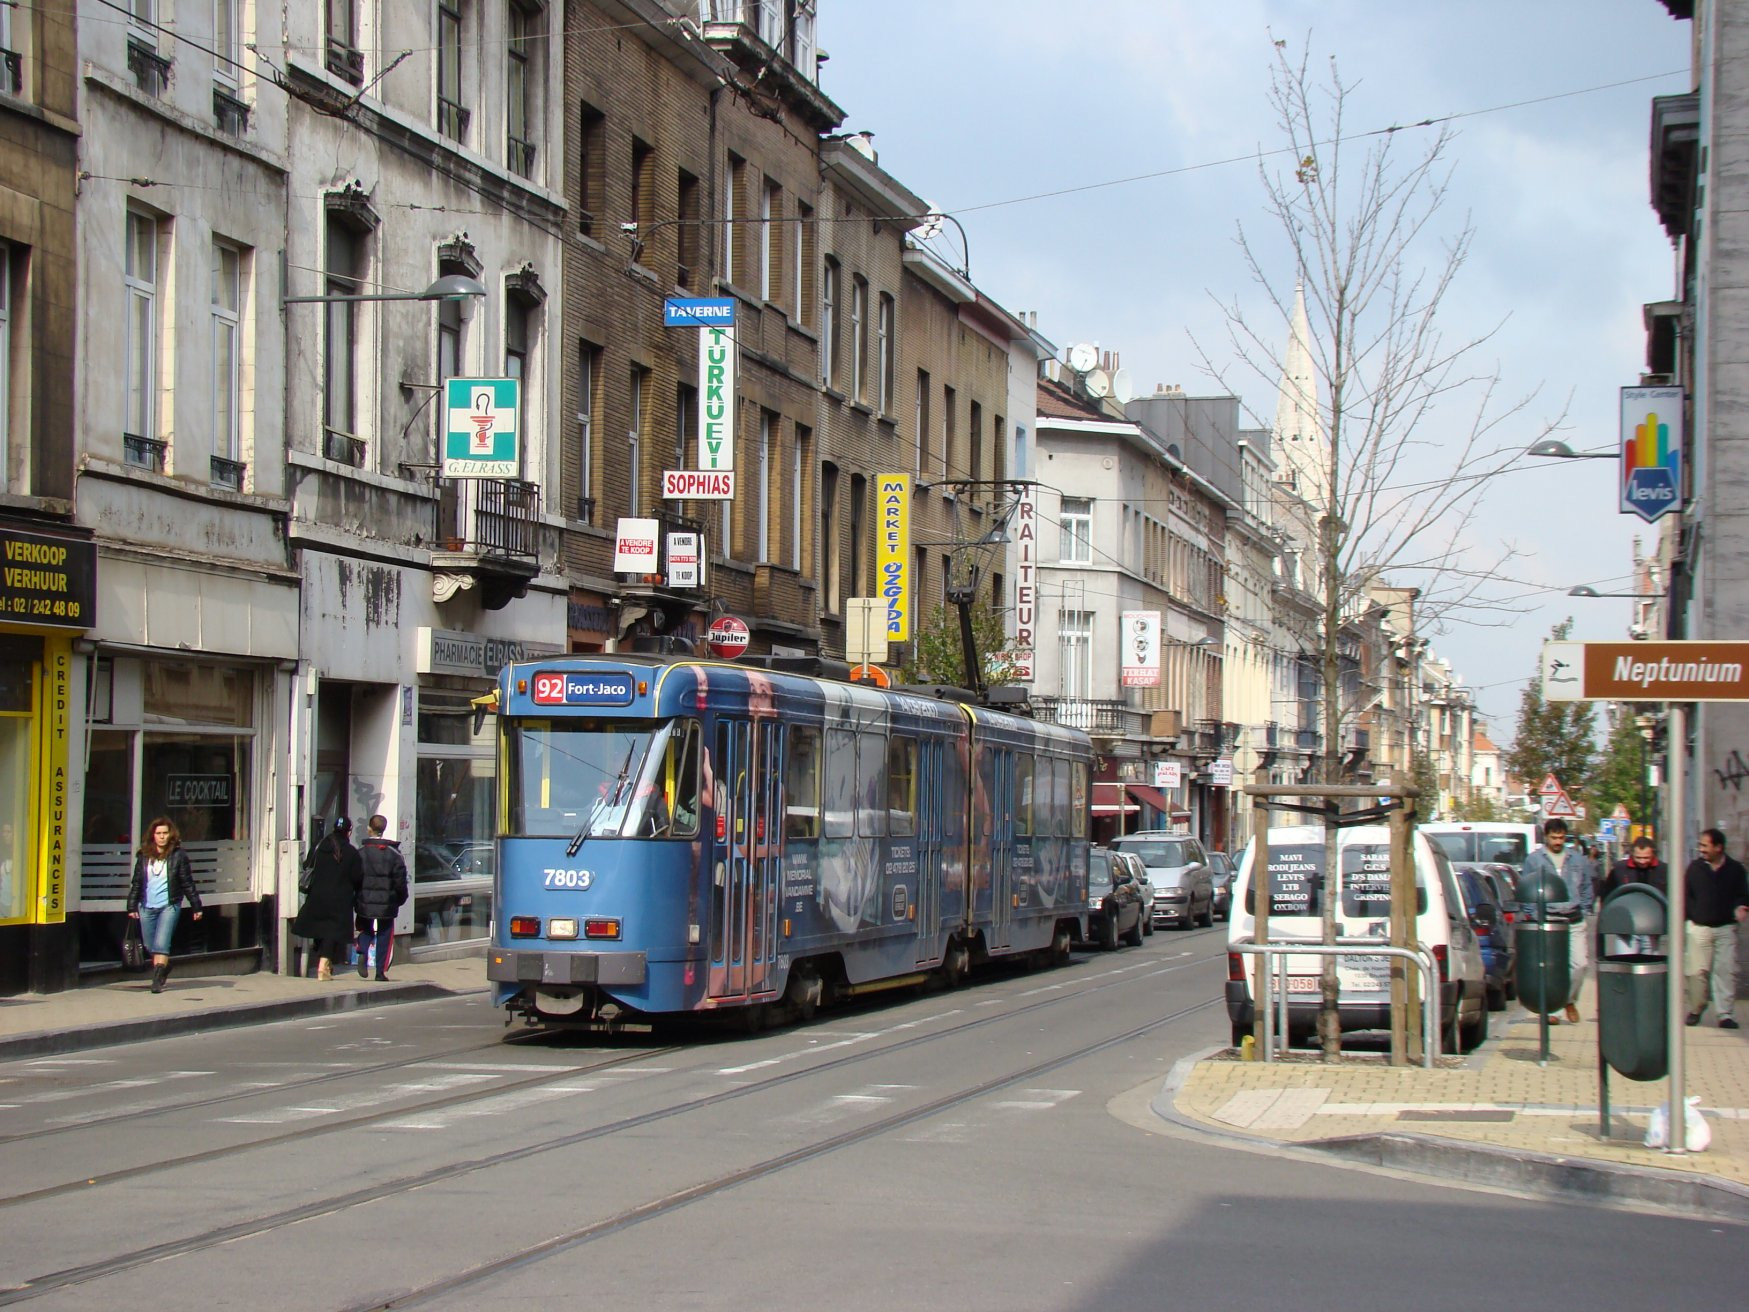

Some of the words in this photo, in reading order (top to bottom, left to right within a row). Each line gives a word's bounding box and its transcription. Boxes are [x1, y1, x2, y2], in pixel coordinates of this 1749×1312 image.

[669, 305, 731, 318] TAVERNE
[666, 474, 731, 495] SOPHIAS
[1632, 480, 1674, 500] levis
[883, 483, 904, 553] MARKET
[630, 546, 650, 554] KOOP
[678, 536, 693, 546] VENDRE
[5, 540, 67, 566] VERKOOP
[1018, 483, 1034, 647] TRAITEUR
[4, 567, 68, 592] VERHUUR
[682, 571, 693, 580] KOOP
[14, 598, 26, 612] 02
[33, 599, 52, 615] 242
[53, 600, 66, 616] 48
[68, 601, 80, 618] 09
[434, 640, 483, 666] PHARMACIE
[1613, 656, 1742, 688] Neptunium
[56, 656, 66, 739] CREDIT
[538, 679, 563, 698] 92
[568, 682, 626, 696] Fort-Jaco
[169, 781, 182, 800] LE
[184, 780, 228, 800] COCKTAIL
[51, 766, 64, 910] ASSURANCES
[1280, 854, 1303, 862] MAVI
[1288, 864, 1316, 872] JEANS
[543, 868, 590, 887] 7803
